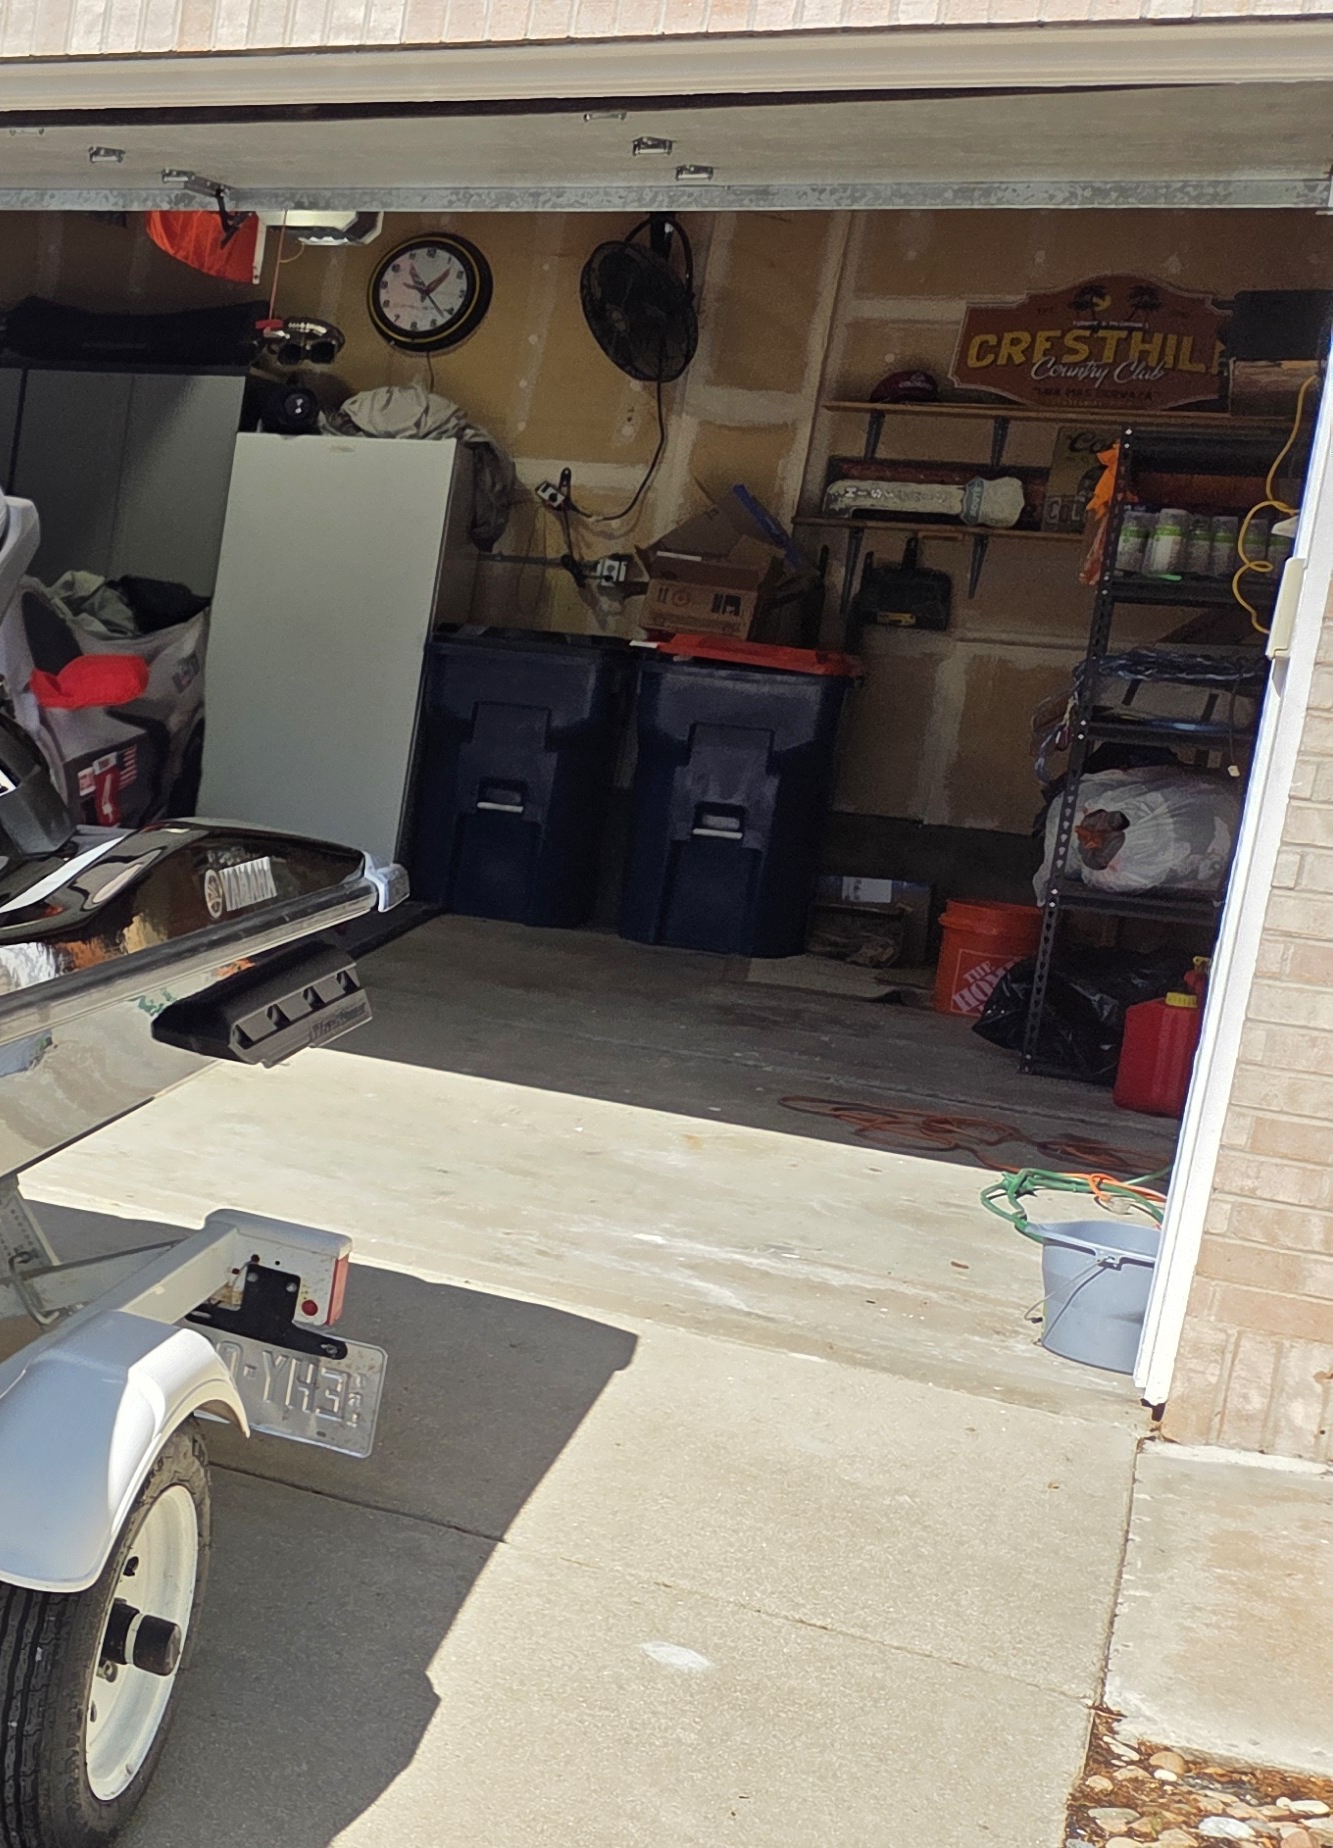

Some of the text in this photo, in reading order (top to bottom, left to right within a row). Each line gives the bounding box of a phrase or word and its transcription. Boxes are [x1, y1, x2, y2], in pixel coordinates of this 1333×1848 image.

[1031, 355, 1165, 388] Country Club
[963, 960, 995, 983] THE
